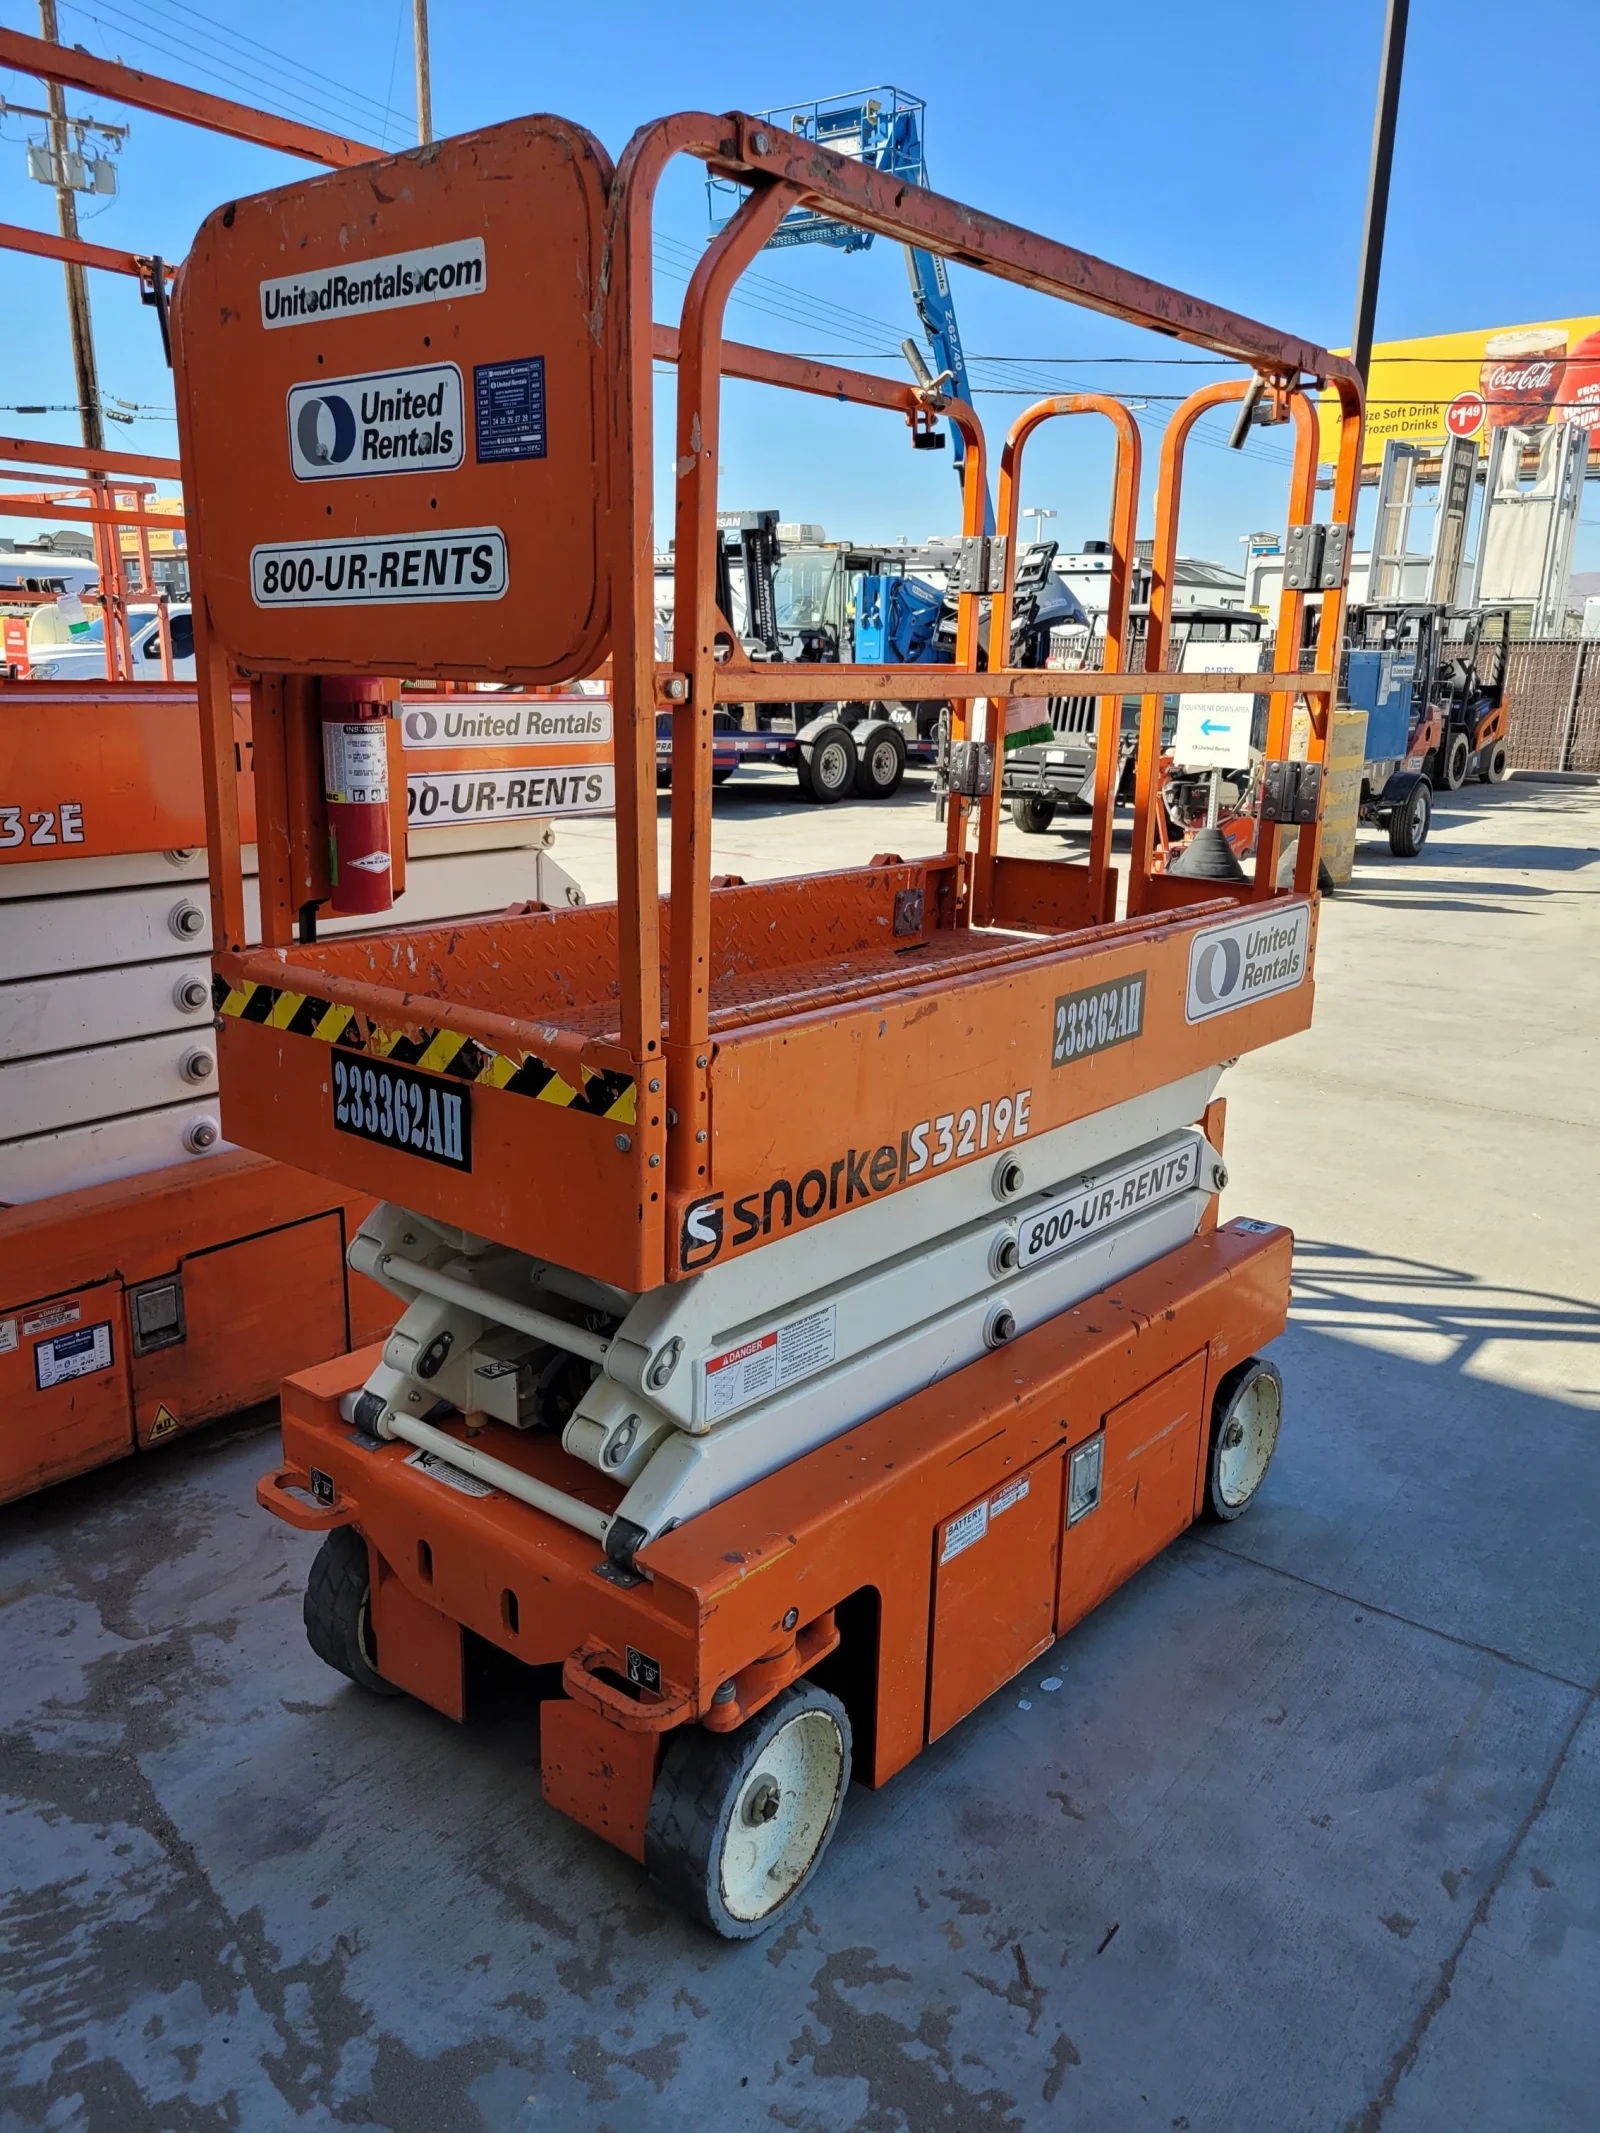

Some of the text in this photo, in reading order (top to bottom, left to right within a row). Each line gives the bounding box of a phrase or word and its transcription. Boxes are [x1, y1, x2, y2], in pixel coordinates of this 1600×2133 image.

[265, 258, 482, 320] UnitedRentals.com
[944, 310, 962, 371] Z-62/40
[1489, 362, 1556, 390] Coca-Cola
[361, 382, 444, 424] United
[1366, 404, 1440, 420] ize Soft Drink
[362, 422, 454, 460] Rentals
[1402, 420, 1438, 432] Drinks
[263, 544, 494, 594] 800-UR-RENTS
[444, 711, 602, 737] United Rentals
[891, 710, 912, 723] 4x4
[1181, 704, 1215, 712] EQUIPMENT
[408, 775, 602, 816] 0-UR-RENTS
[1246, 920, 1298, 960] United
[1242, 950, 1299, 990] Rentals
[1054, 981, 1142, 1060] 233362AH
[335, 1061, 463, 1162] 233362AH
[732, 1130, 908, 1246] snorkel
[908, 1089, 1032, 1176] S3219E
[1028, 1154, 1189, 1254] 800-UR-RENTS
[43, 1306, 65, 1316] DANGER
[729, 1340, 763, 1363] DANGER
[948, 1506, 983, 1536] BATTERY
